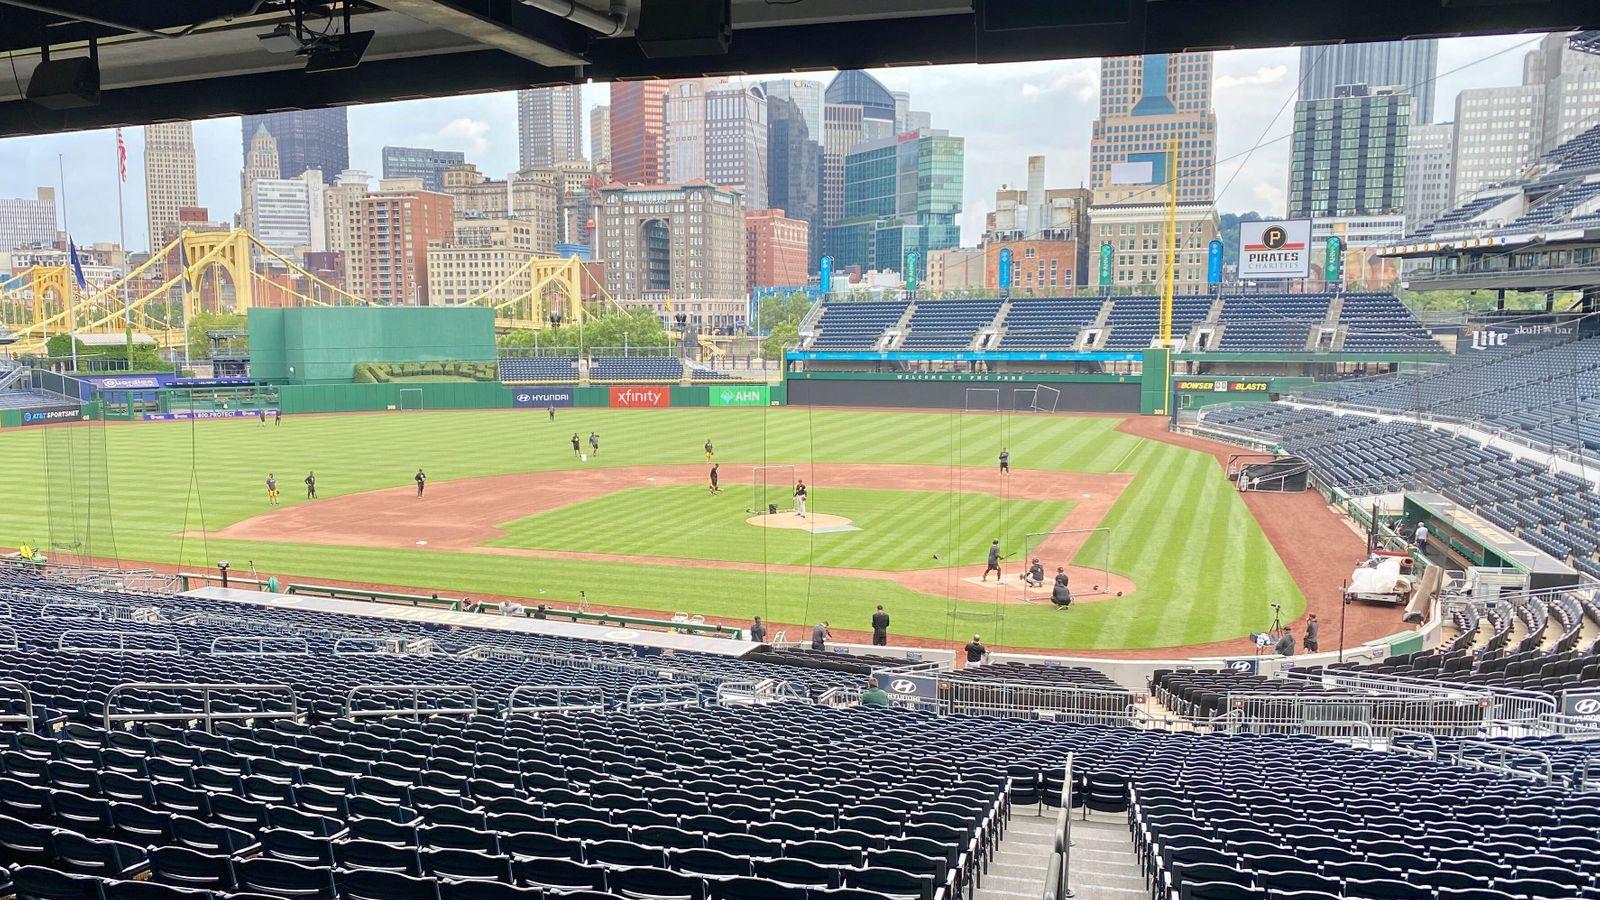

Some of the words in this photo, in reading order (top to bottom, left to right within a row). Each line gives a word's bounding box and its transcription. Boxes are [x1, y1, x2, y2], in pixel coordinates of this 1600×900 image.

[1269, 230, 1281, 246] P
[1249, 252, 1299, 262] PIRATES
[1514, 325, 1541, 335] skull
[1554, 326, 1573, 335] bar
[1470, 330, 1509, 350] Lite
[1180, 381, 1214, 390] BOWSER
[1235, 382, 1267, 390] BLASTS
[532, 393, 569, 401] HYUNDAI
[617, 388, 662, 405] xfinity
[735, 391, 760, 401] AHN
[47, 409, 80, 419] SPORTSNET
